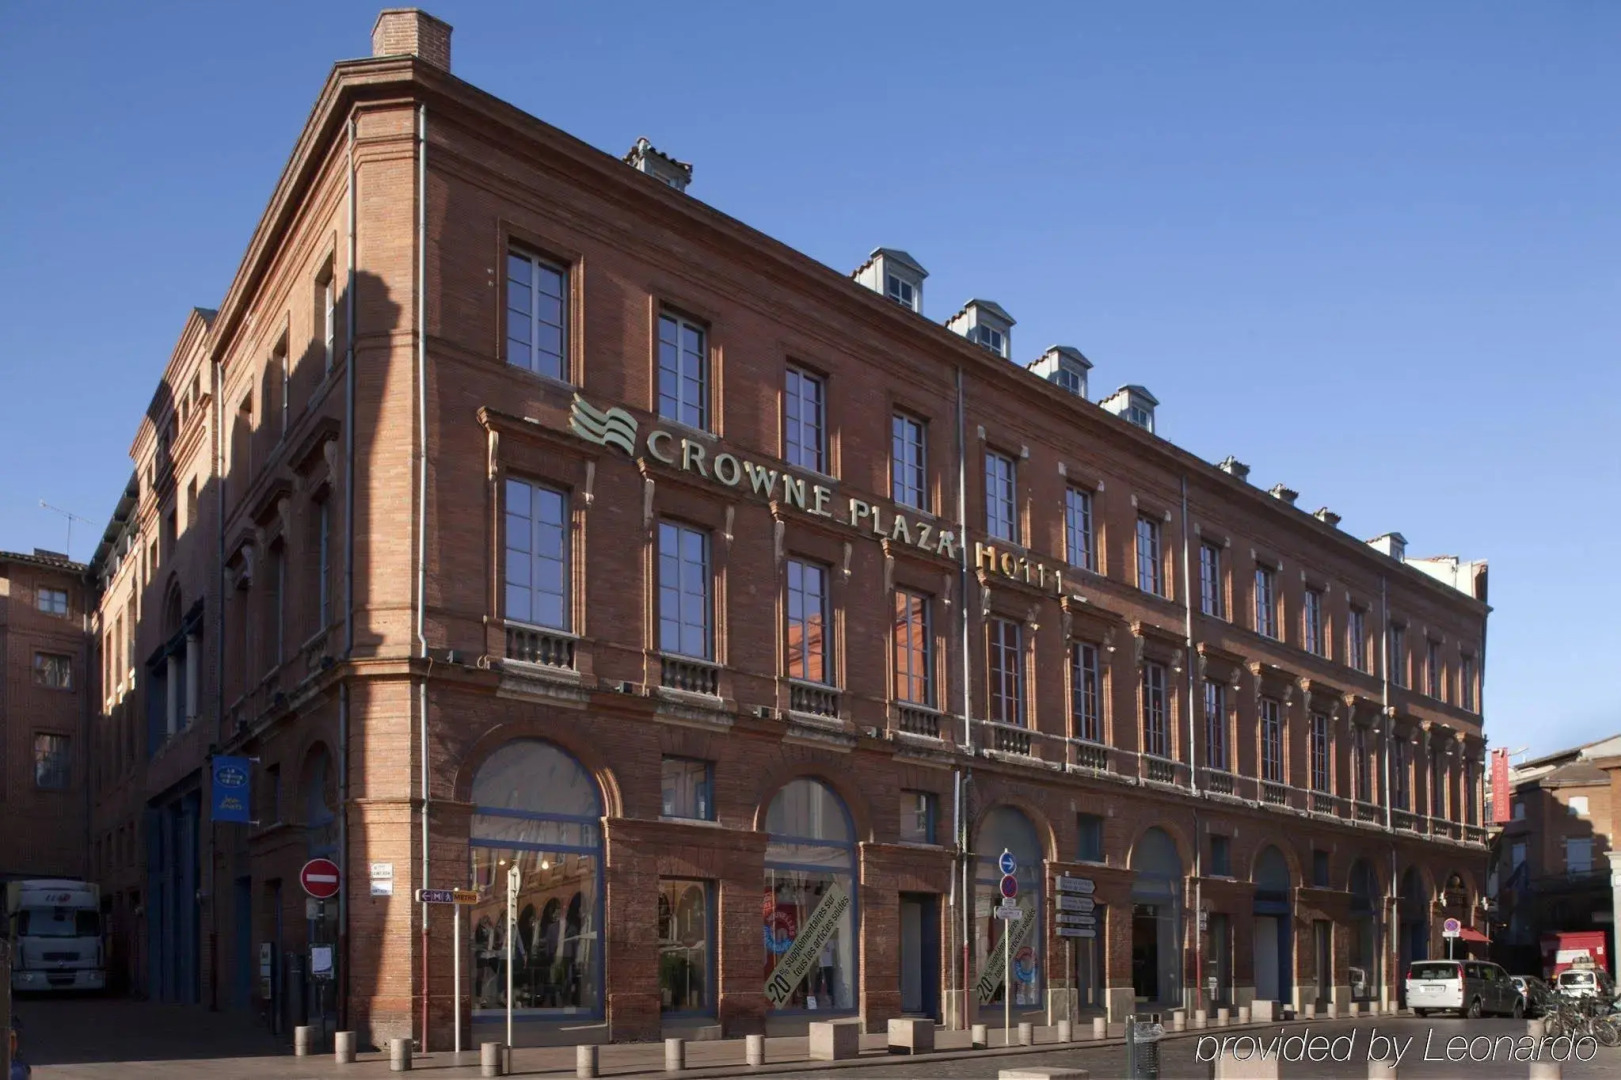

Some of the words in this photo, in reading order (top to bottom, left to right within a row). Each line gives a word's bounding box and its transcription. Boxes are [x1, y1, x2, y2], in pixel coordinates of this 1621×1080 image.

[646, 430, 832, 518] CROWNE
[850, 498, 955, 559] PLAZA
[825, 894, 835, 909] sur
[793, 959, 808, 977] tous
[804, 946, 817, 961] les
[813, 920, 834, 949] articles
